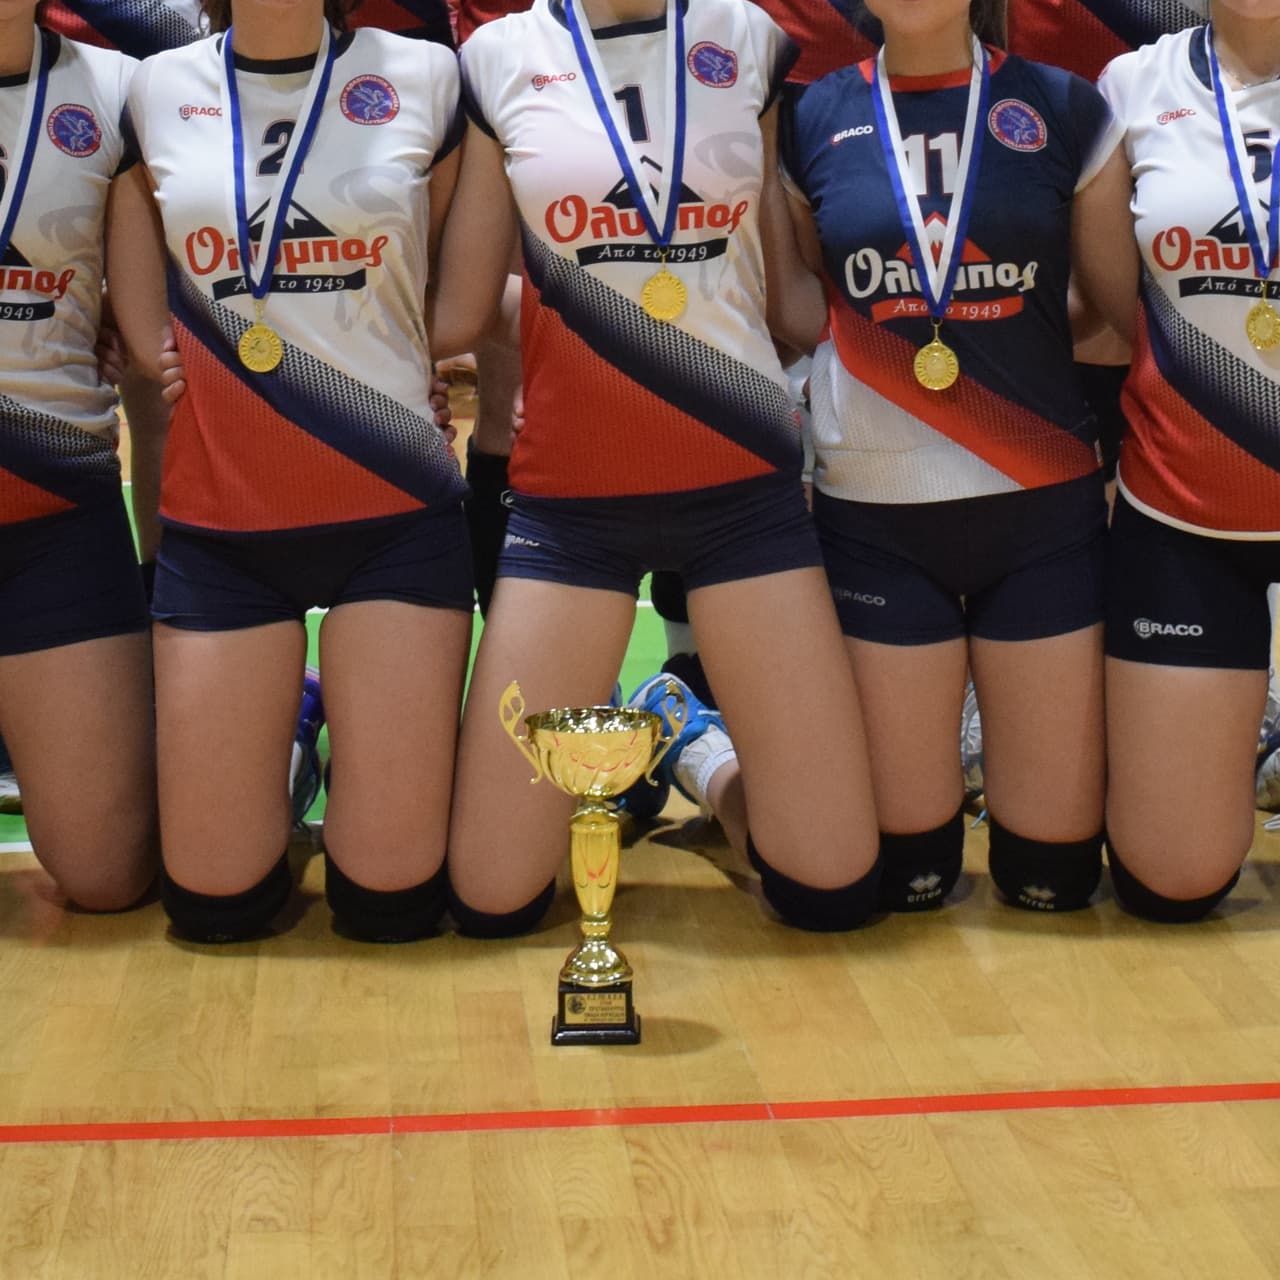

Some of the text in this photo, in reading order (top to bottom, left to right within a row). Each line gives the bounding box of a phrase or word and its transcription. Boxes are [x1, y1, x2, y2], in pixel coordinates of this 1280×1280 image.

[531, 71, 577, 91] BRACO
[613, 83, 651, 144] 1
[830, 124, 874, 146] BRACO
[255, 117, 305, 178] 2
[900, 131, 962, 199] 11
[544, 194, 749, 243] Ολυπος
[668, 246, 708, 262] 1949
[303, 277, 345, 291] 1949
[961, 302, 1002, 319] 1949
[1133, 617, 1204, 638] BRACO
